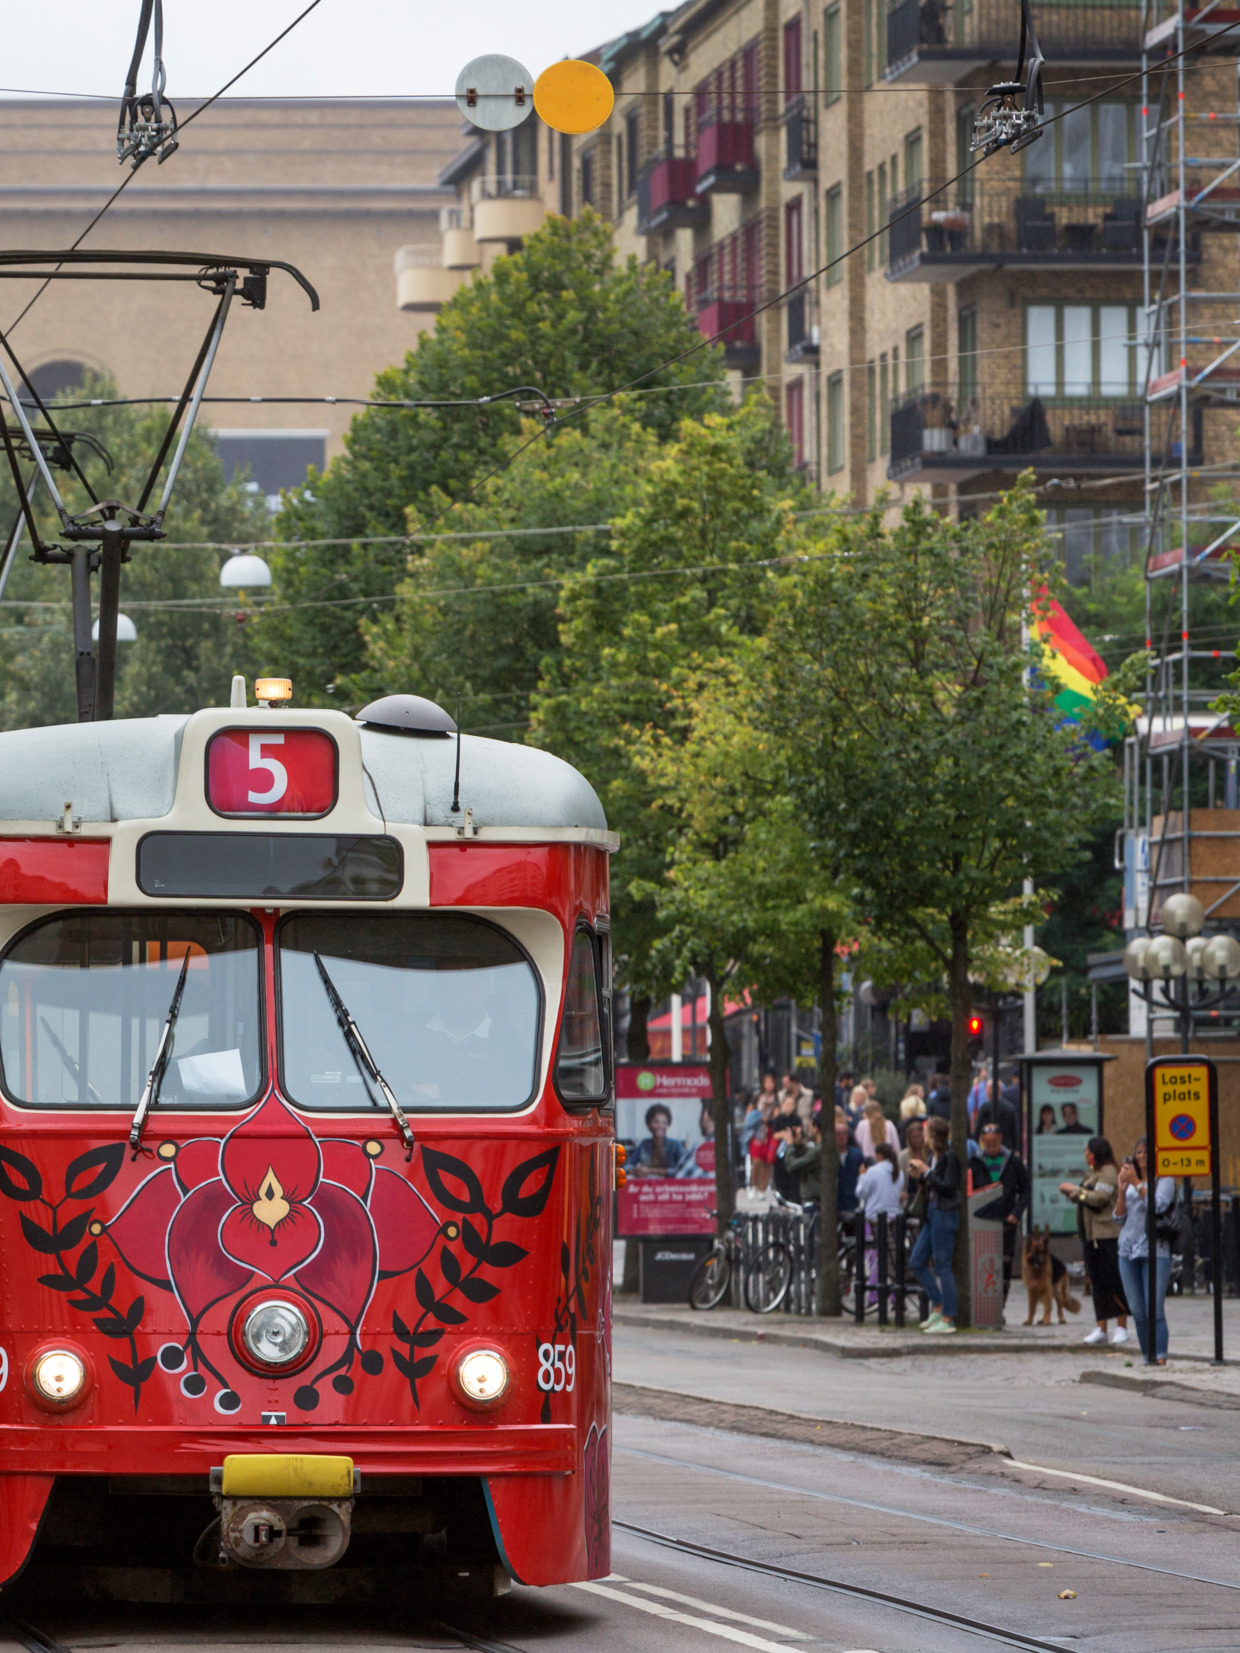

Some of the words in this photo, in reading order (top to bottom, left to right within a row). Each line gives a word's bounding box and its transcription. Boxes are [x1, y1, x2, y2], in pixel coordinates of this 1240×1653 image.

[247, 733, 288, 804] 5
[655, 1074, 710, 1088] Hermods
[1161, 1073, 1201, 1086] Last-
[1162, 1090, 1201, 1105] plats
[1195, 1158, 1206, 1168] m
[538, 1342, 576, 1392] 859
